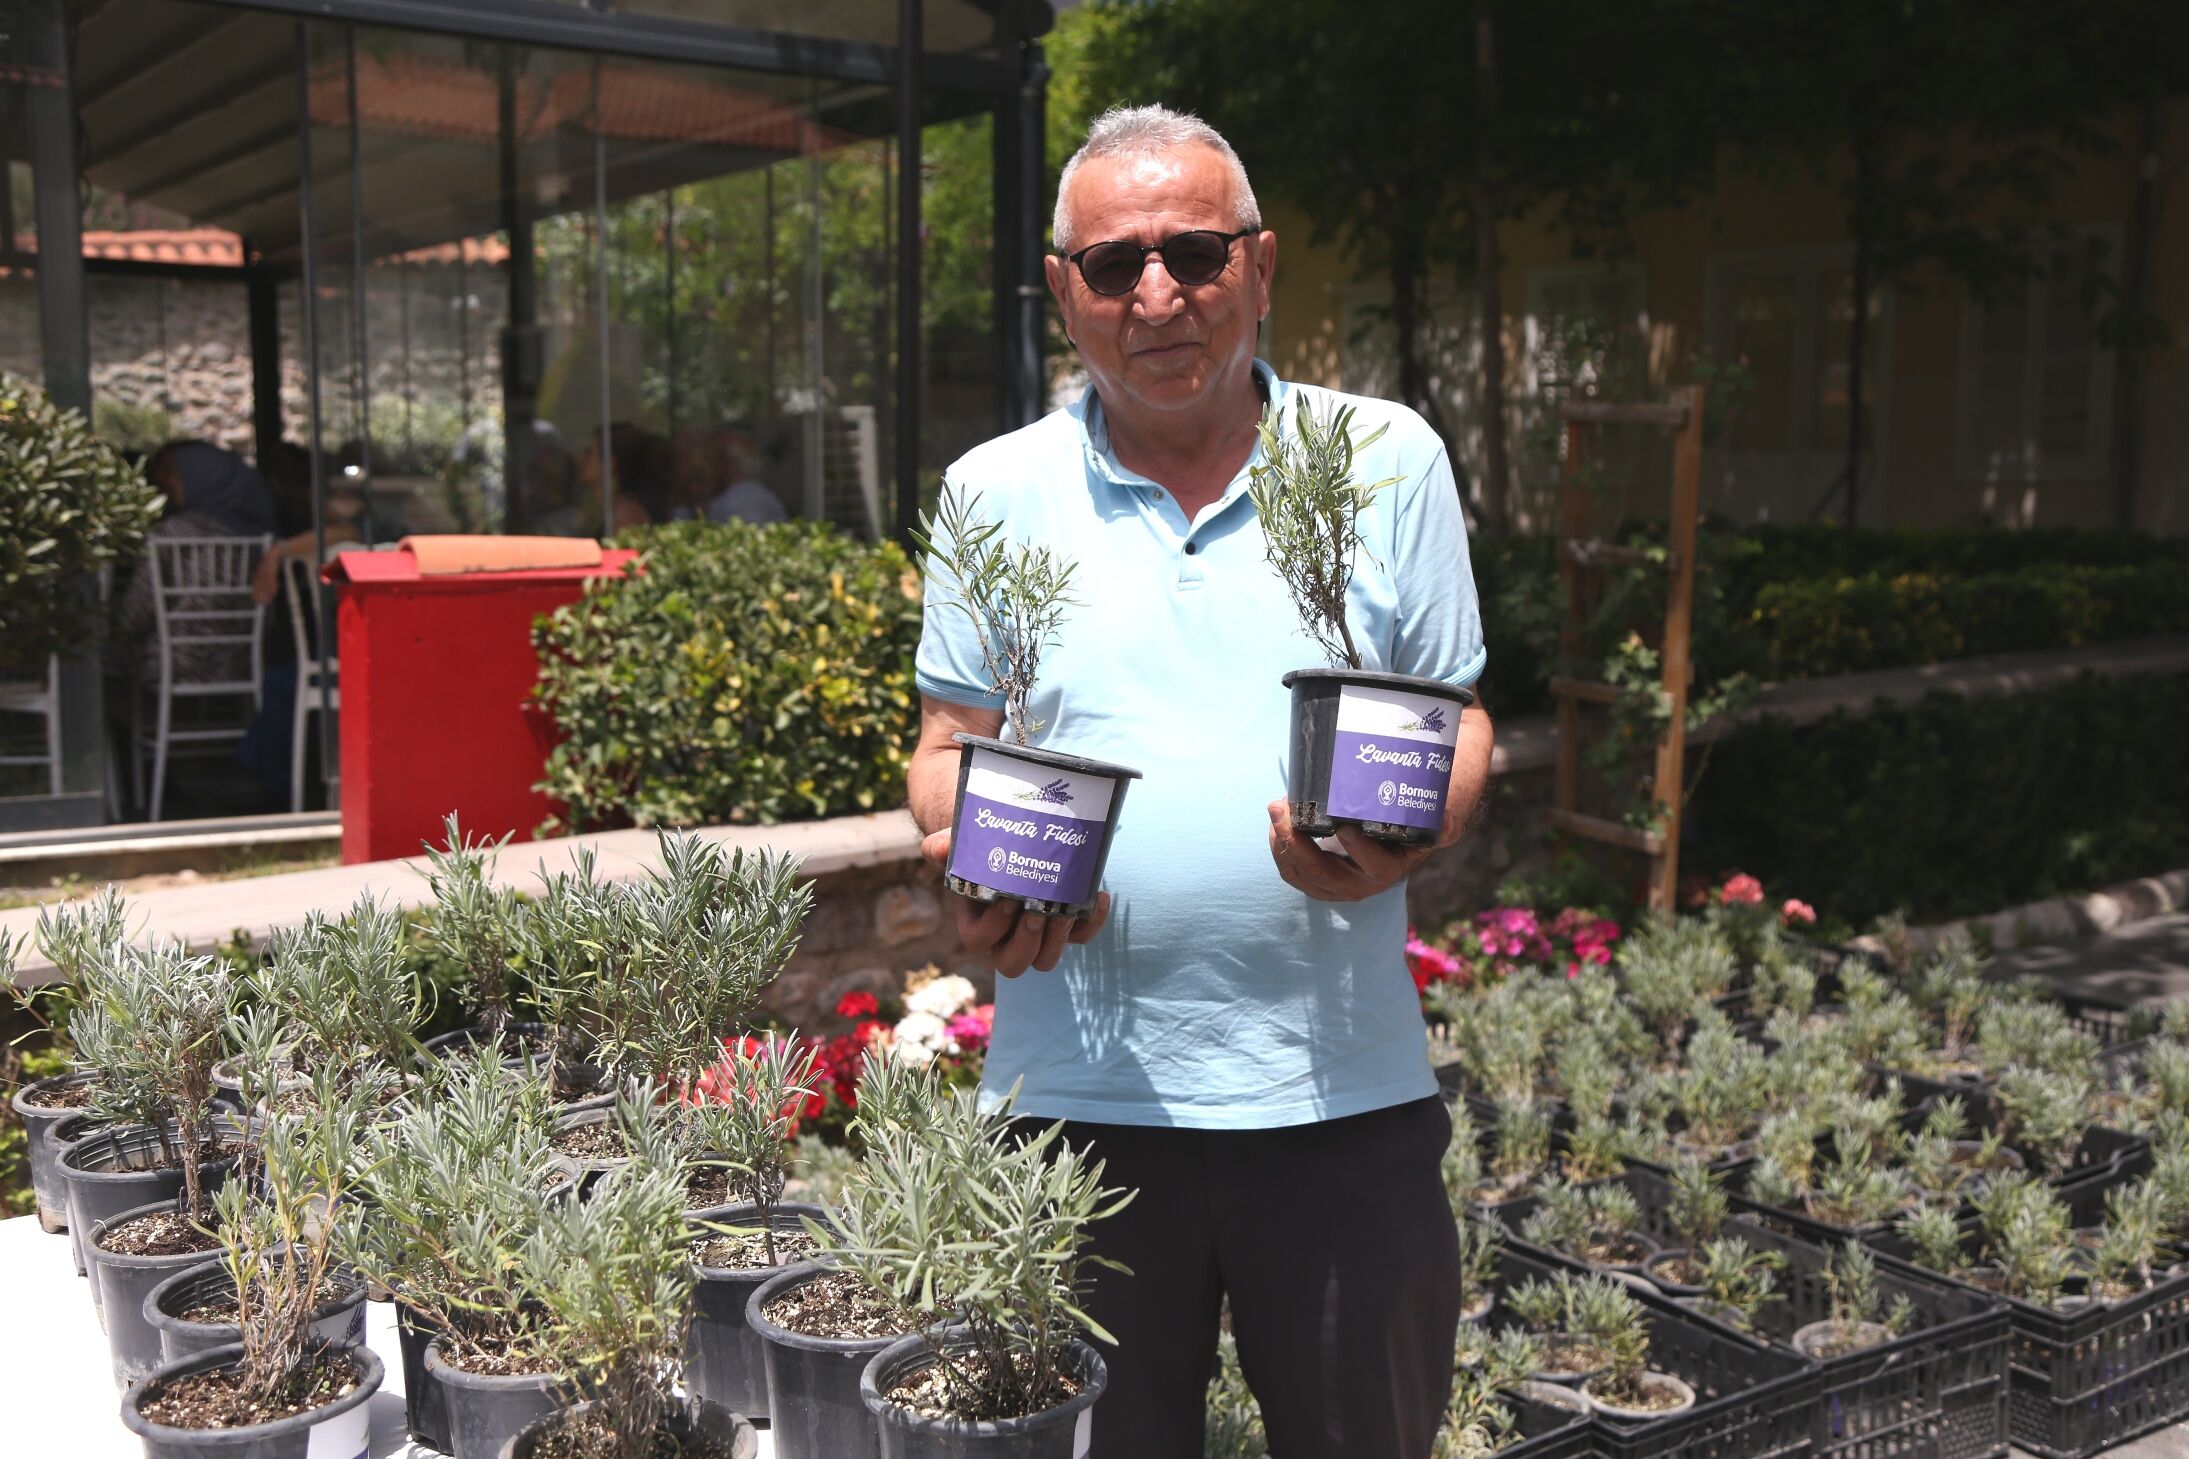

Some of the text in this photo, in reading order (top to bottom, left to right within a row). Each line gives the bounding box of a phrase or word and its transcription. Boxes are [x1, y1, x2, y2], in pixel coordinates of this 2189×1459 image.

[1355, 743, 1423, 769] Lavanta
[1399, 782, 1438, 800] Bornova
[1397, 796, 1437, 812] Belediyesi
[974, 807, 1089, 847] Lavanta Fidesi
[1008, 851, 1062, 873] Bornova
[1006, 864, 1059, 884] Belediyesi
